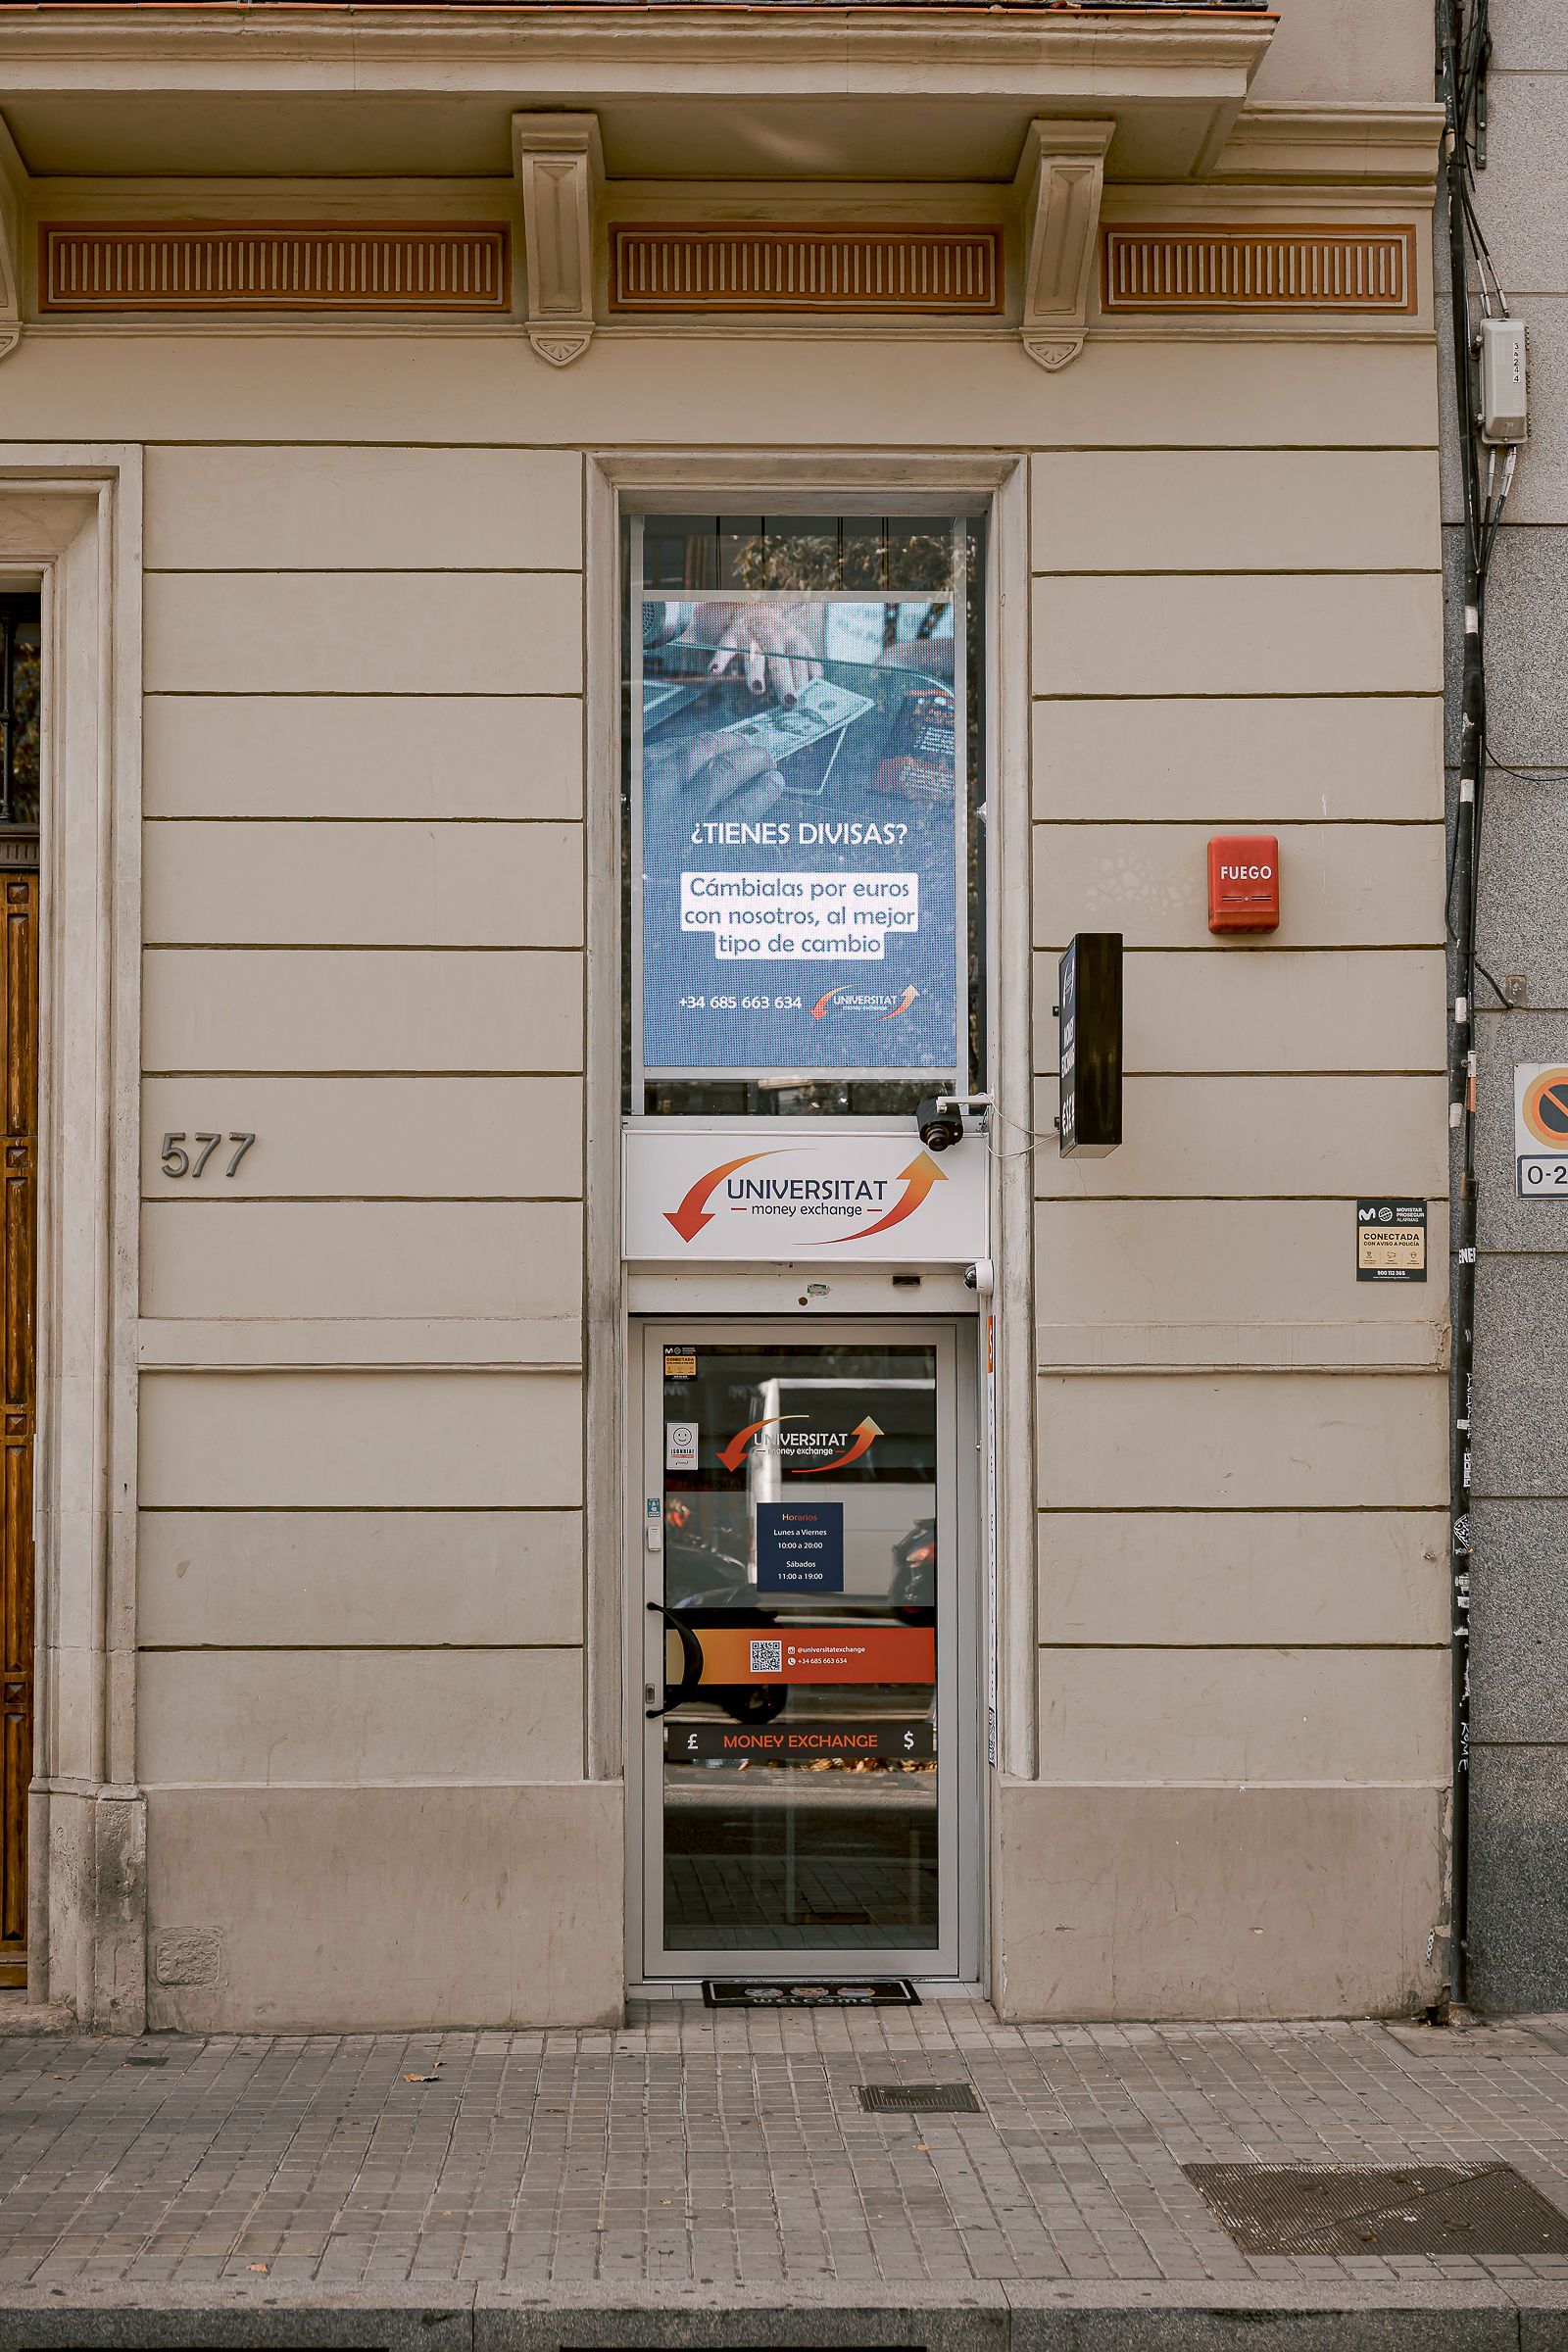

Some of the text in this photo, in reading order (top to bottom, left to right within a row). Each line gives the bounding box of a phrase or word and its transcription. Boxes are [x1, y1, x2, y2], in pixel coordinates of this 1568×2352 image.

[691, 822, 908, 846] ¿TIENES DIVISAS?
[1220, 865, 1272, 880] FUEGO
[690, 875, 909, 902] Cámbialas por euros
[684, 905, 915, 929] con nosotros, al mejor
[718, 933, 881, 956] tipo de cambio
[679, 996, 803, 1009] +34 685 663 634
[833, 995, 898, 1005] UNIVERSITAT
[162, 1132, 256, 1178] 577
[727, 1179, 888, 1200] UNIVERSITAT
[751, 1202, 862, 1217] money exchange
[754, 1433, 849, 1446] UNIVERSITAT
[797, 1446, 834, 1456] exchange
[782, 1513, 818, 1522] Horarios
[687, 1731, 914, 1750] £ MONEY EXCHANGE $
